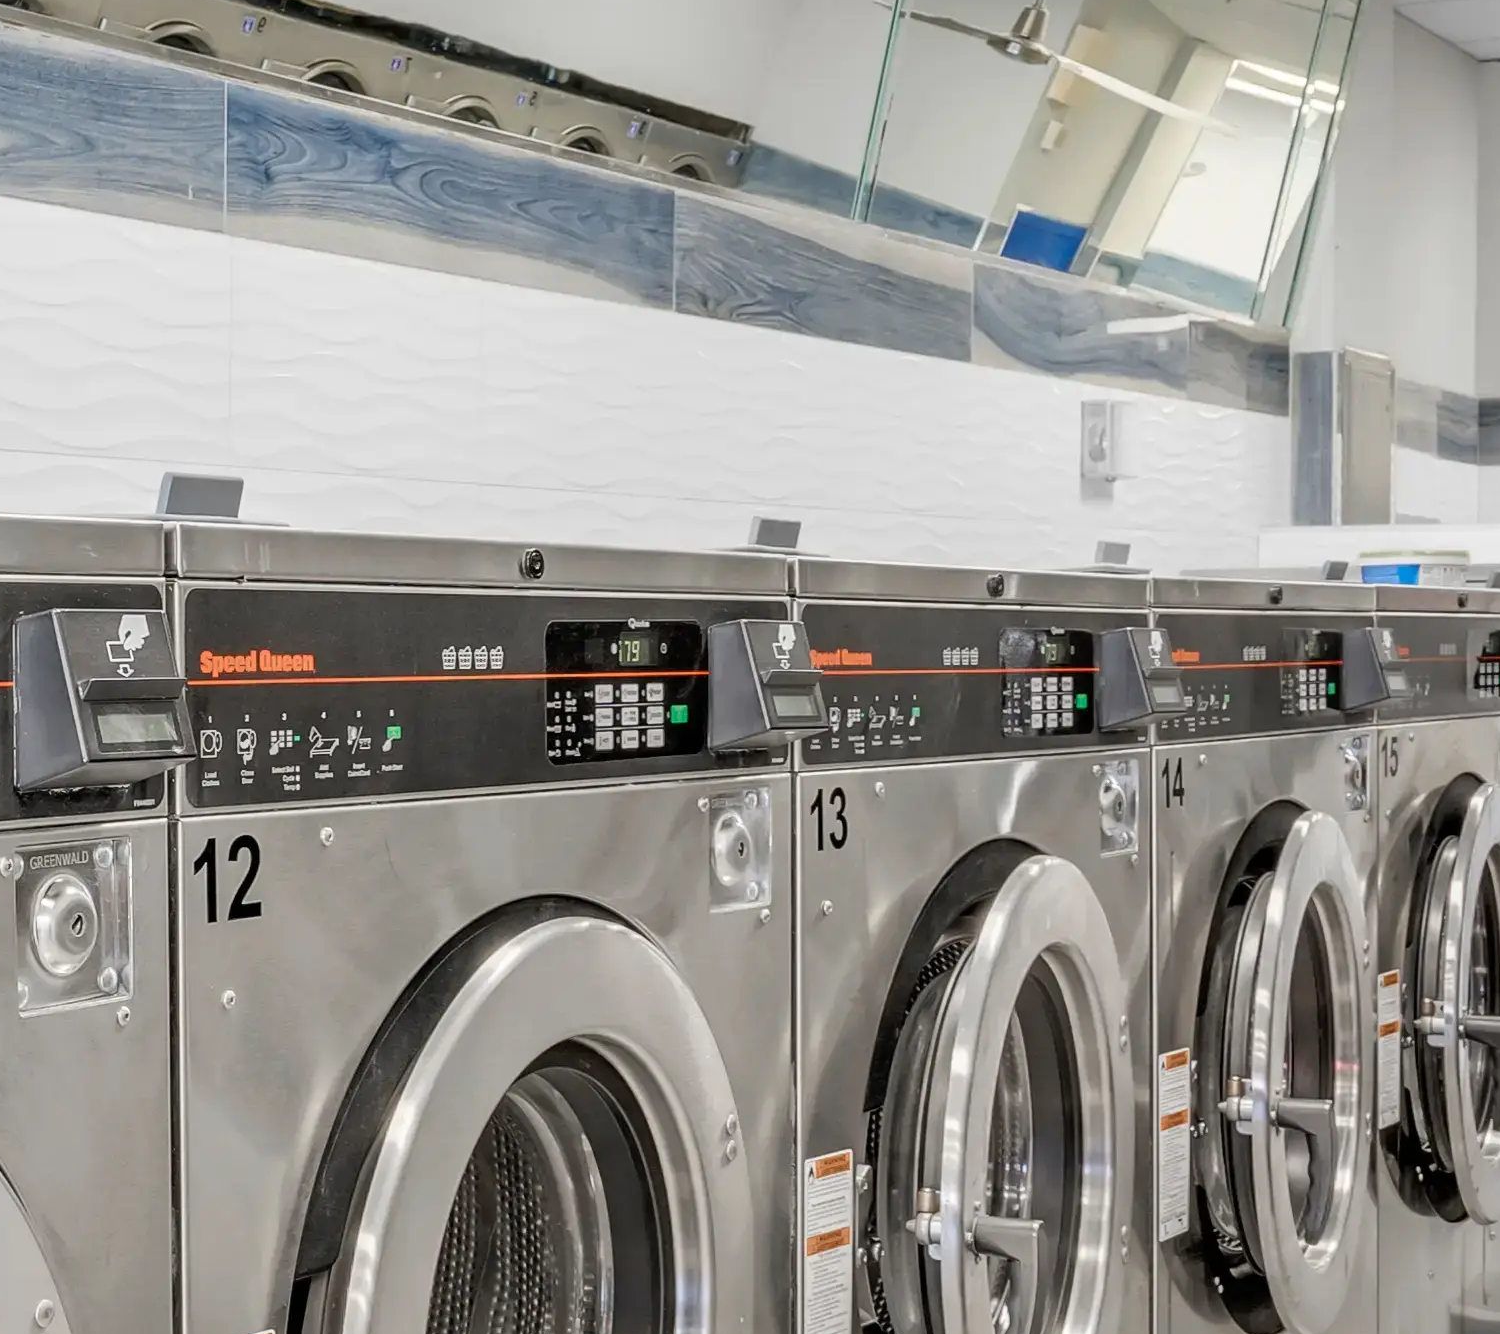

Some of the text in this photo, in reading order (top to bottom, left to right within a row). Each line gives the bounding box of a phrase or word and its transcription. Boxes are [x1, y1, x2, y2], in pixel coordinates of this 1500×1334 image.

[200, 649, 315, 677] Speed Queen
[1382, 737, 1399, 777] 15
[1161, 757, 1185, 808] 14
[810, 787, 847, 851] 13
[30, 850, 89, 870] GREENWALD
[193, 834, 263, 924] 12
